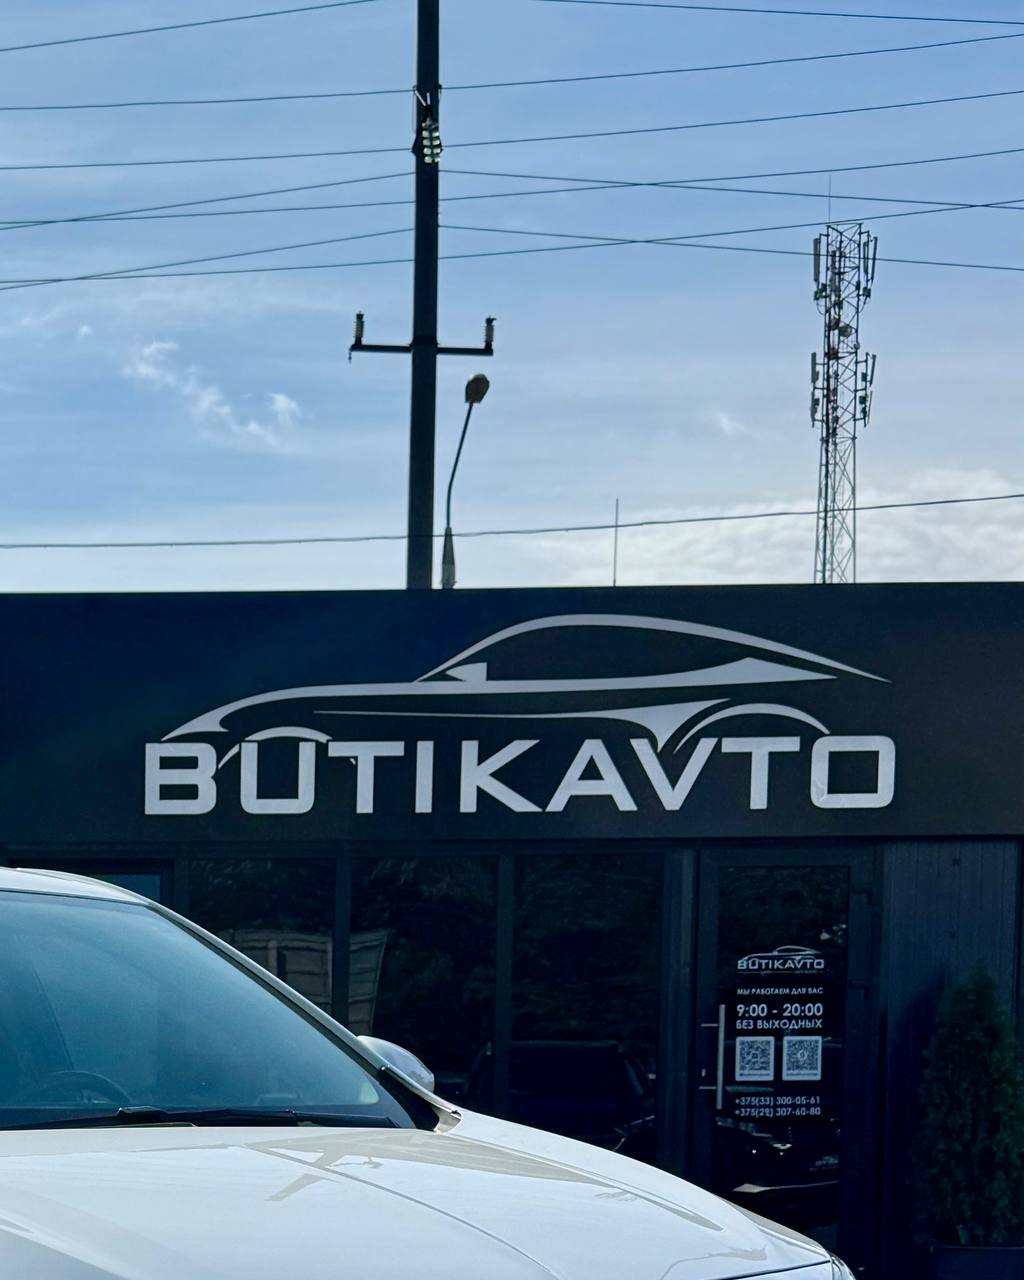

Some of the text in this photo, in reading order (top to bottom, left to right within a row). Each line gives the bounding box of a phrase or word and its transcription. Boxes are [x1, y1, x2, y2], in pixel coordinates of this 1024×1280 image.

[145, 735, 896, 815] BUTIKAVTO
[737, 958, 825, 970] BUTIKAVTO
[751, 987, 790, 995] РАБОТАЕМ
[791, 987, 806, 996] ДЛЯ
[736, 1004, 767, 1017] 9:00
[782, 1003, 823, 1016] 20:00
[736, 1018, 823, 1029] БЕЗ ВЫХОДНЫХ
[735, 1096, 773, 1106] +375(33)
